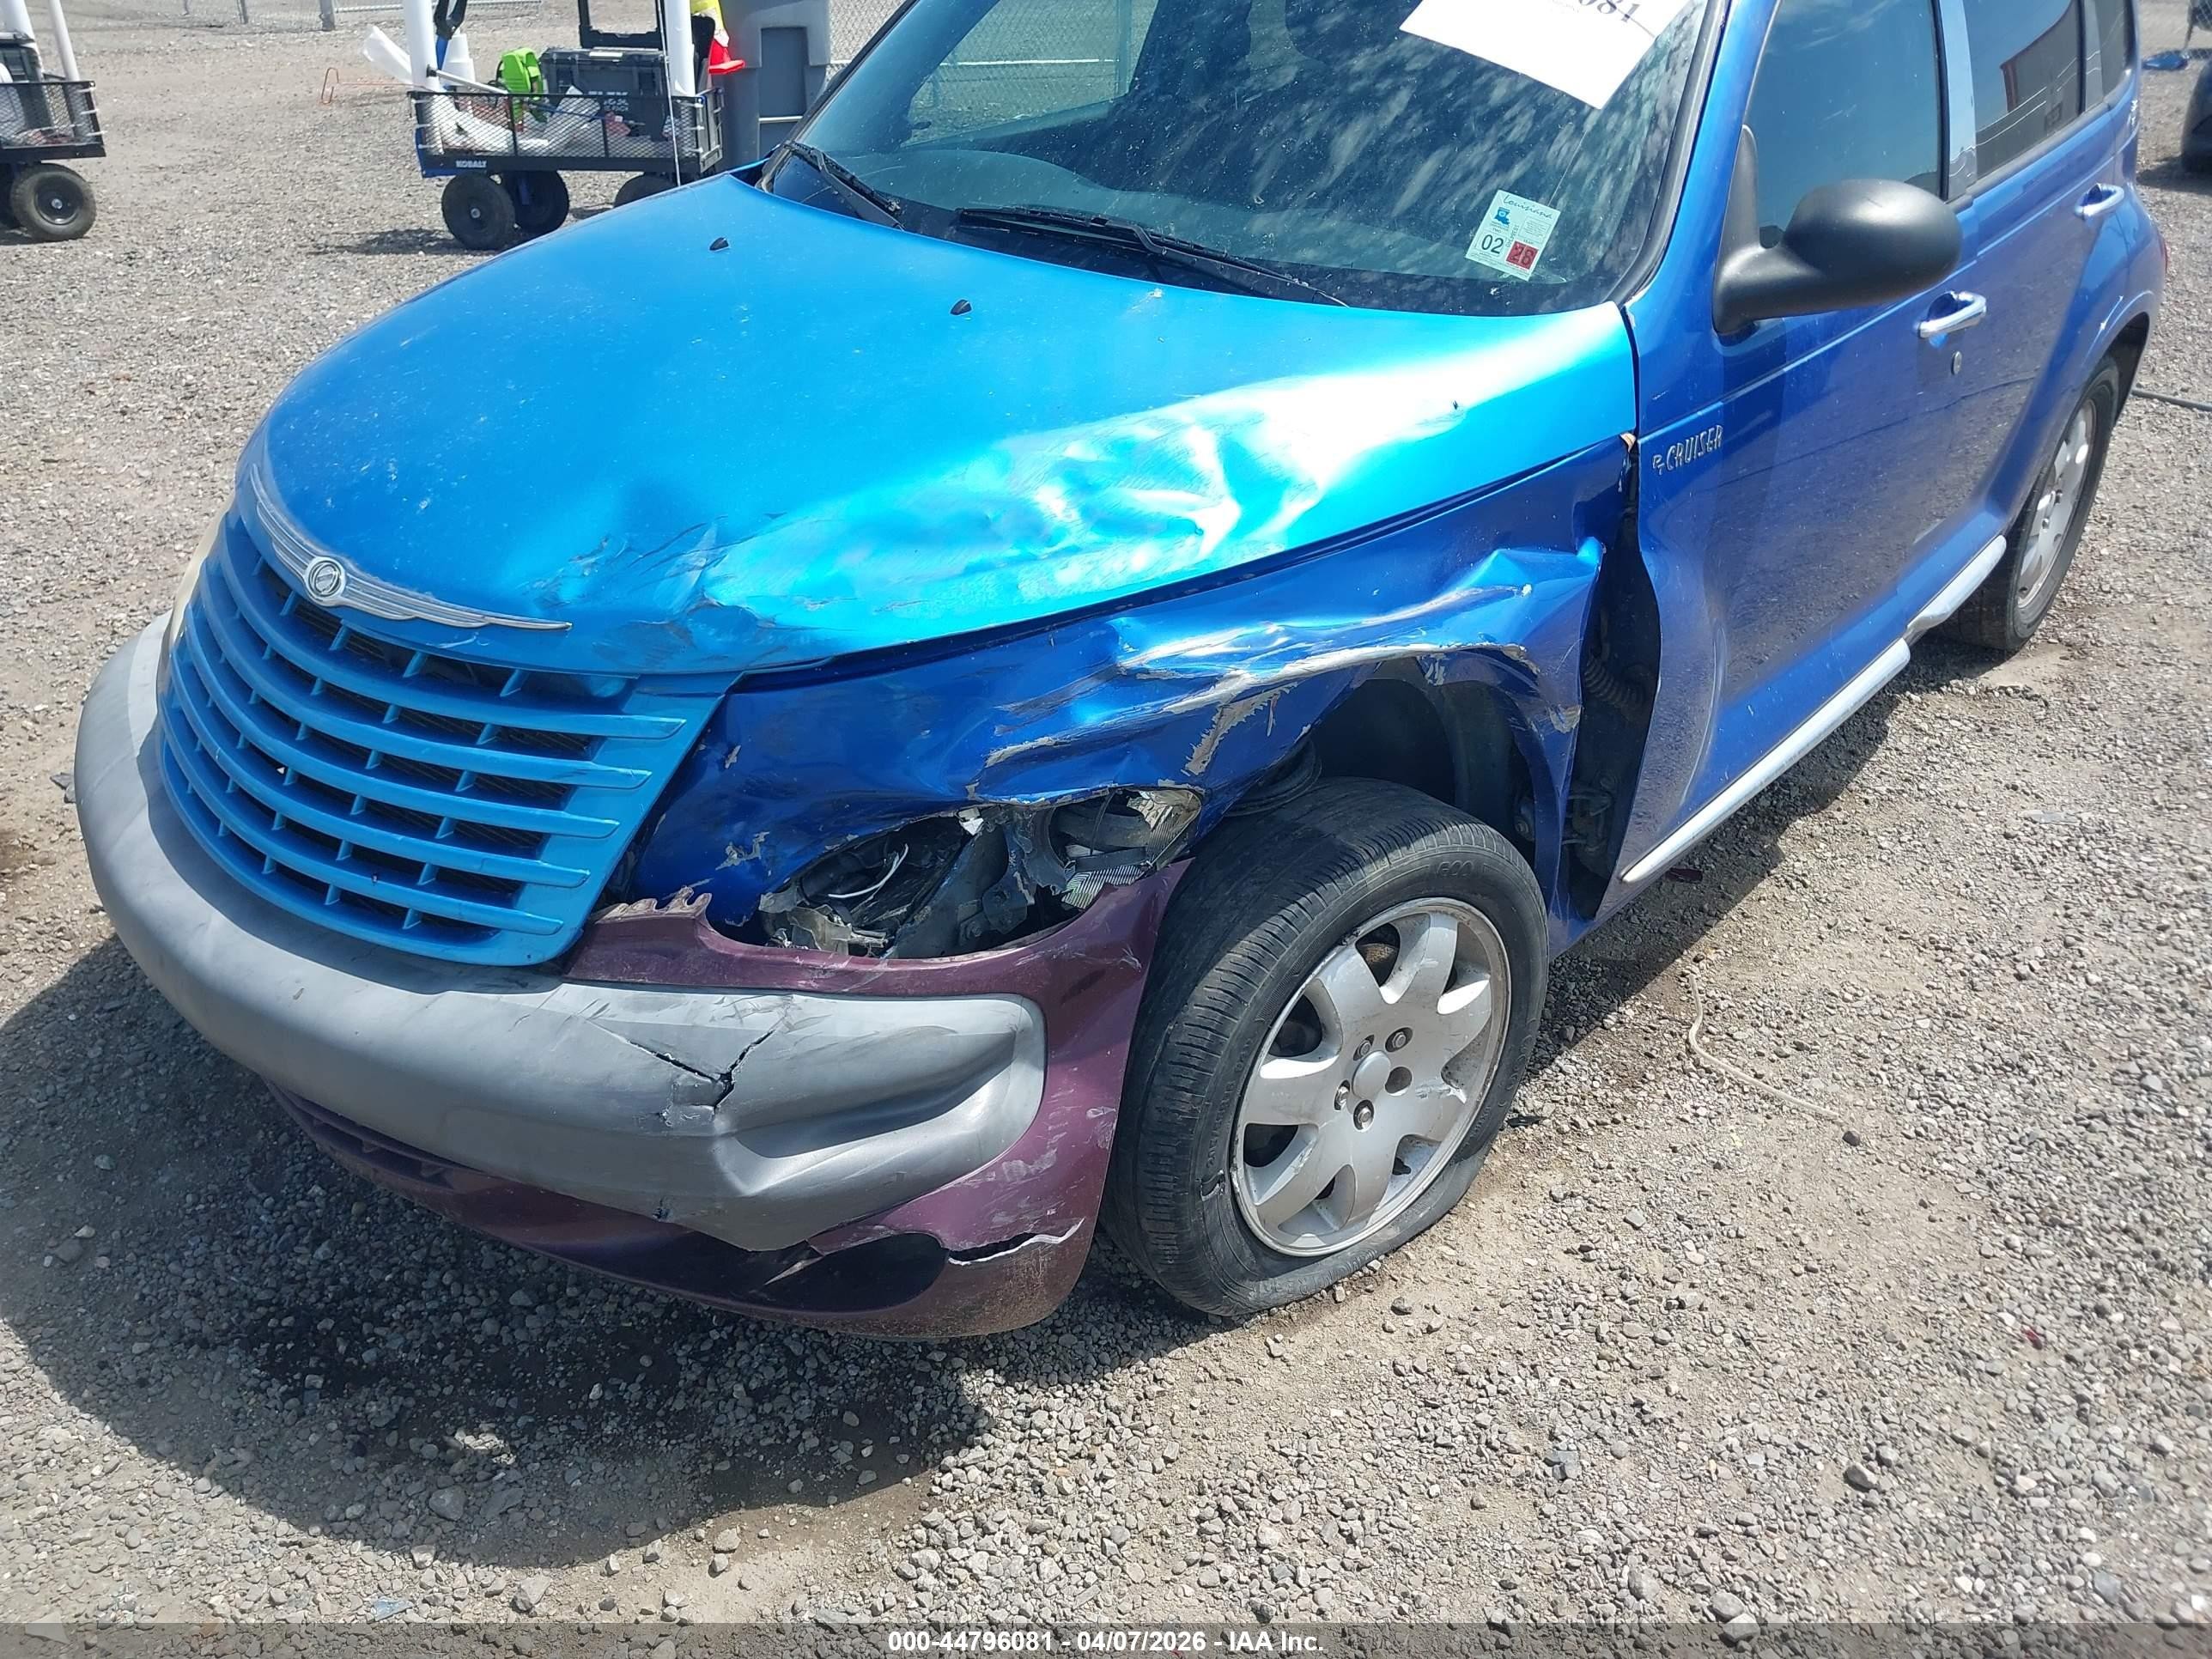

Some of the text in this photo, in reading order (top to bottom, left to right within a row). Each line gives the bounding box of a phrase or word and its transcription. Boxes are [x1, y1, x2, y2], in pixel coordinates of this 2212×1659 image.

[1578, 0, 1640, 23] 81
[455, 160, 487, 168] KOBALT
[1503, 194, 1553, 220] Louisiana
[1481, 234, 1504, 254] 02
[1666, 424, 1724, 471] CRUISER
